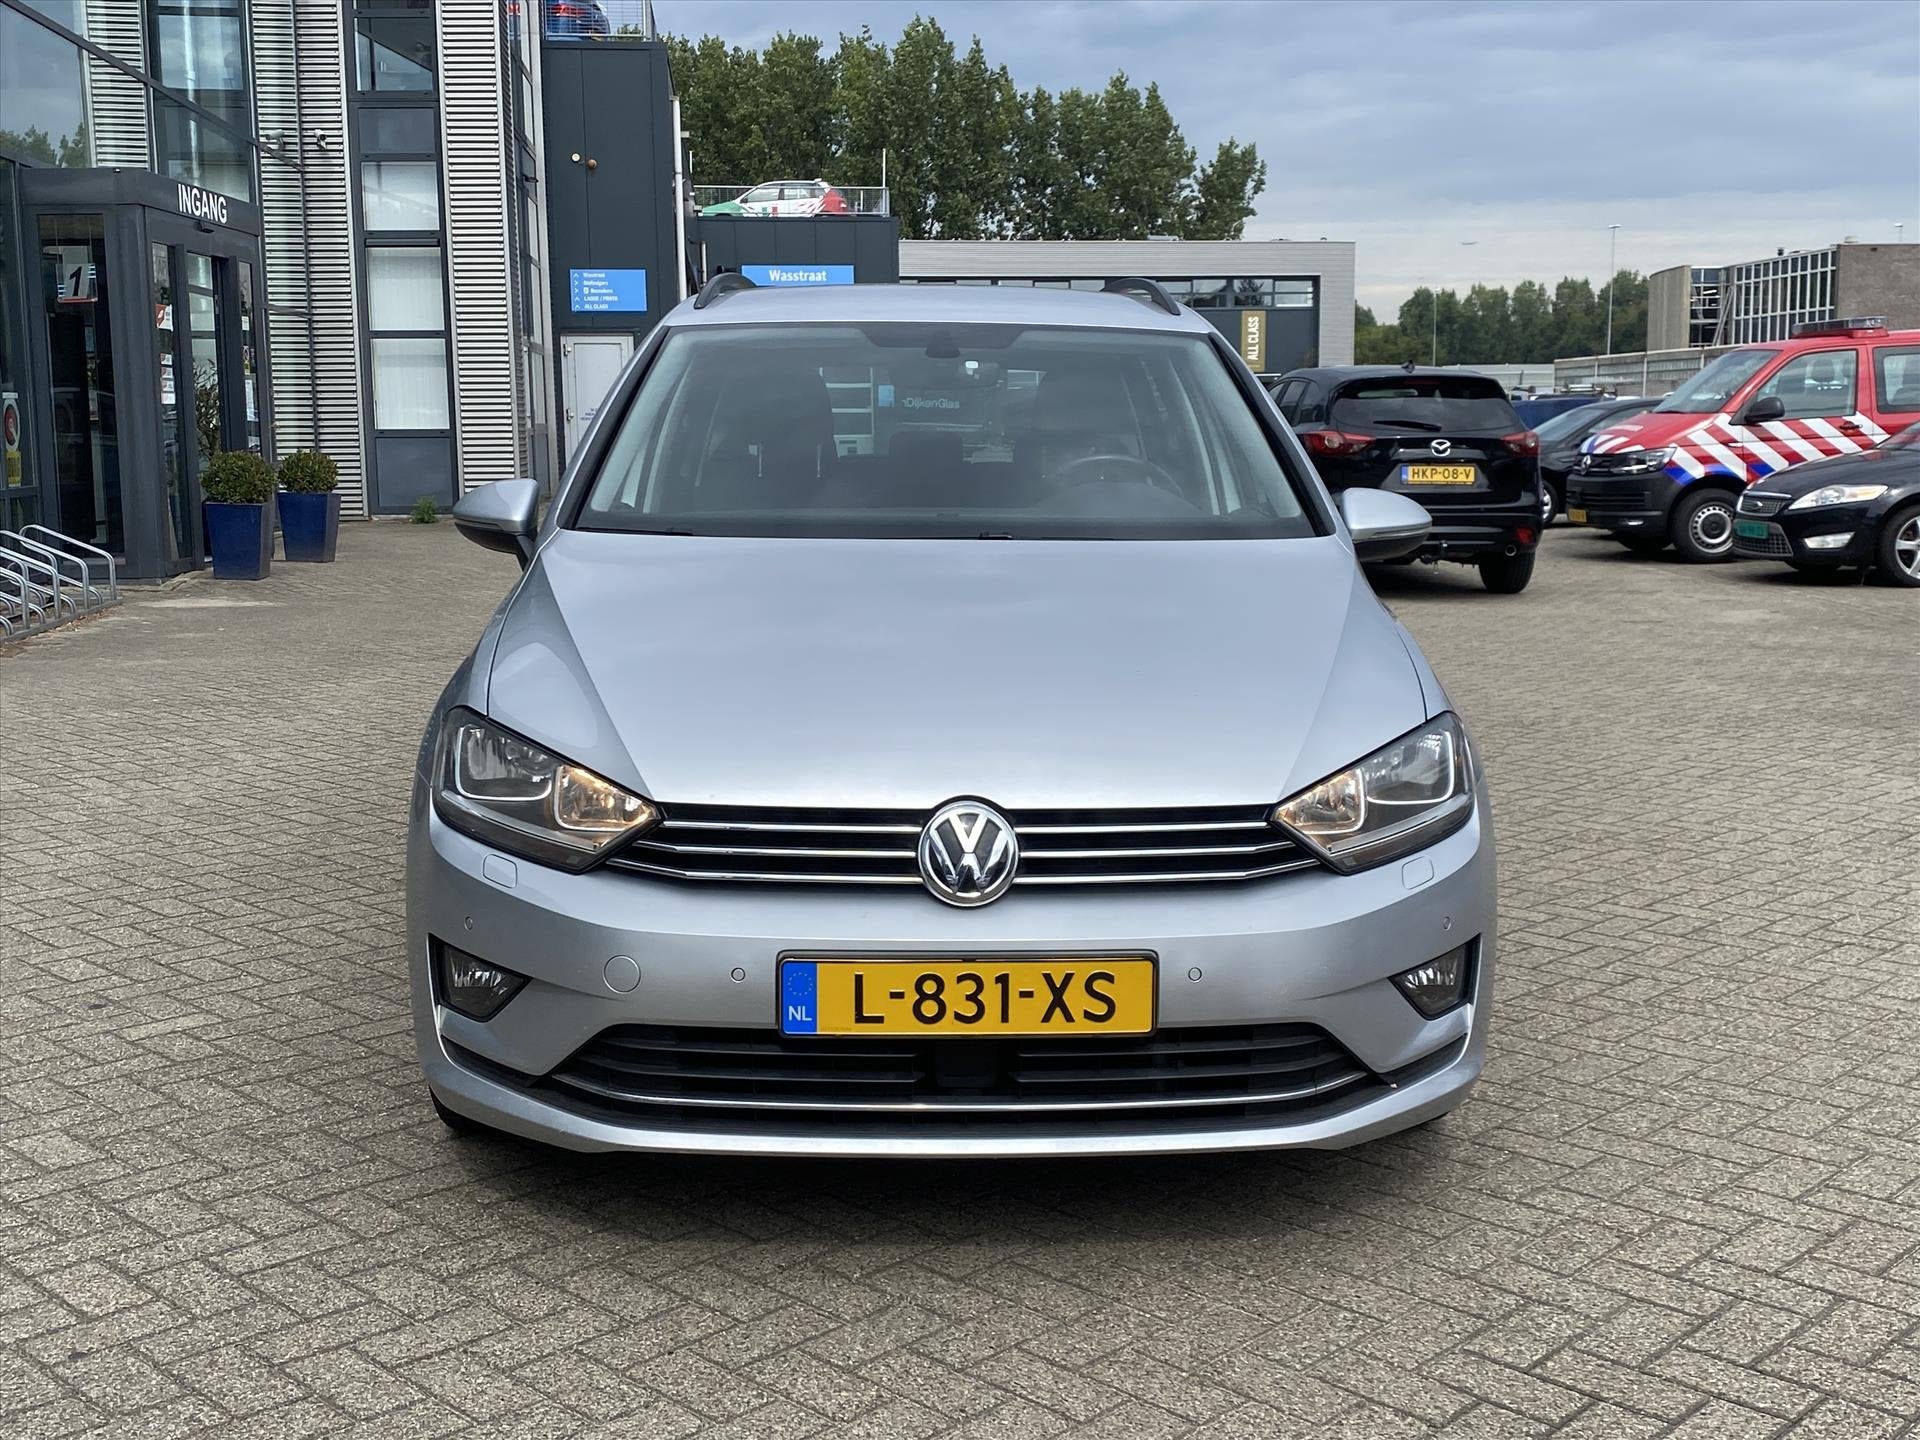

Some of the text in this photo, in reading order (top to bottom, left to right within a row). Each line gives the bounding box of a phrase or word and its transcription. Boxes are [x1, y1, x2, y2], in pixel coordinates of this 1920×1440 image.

[177, 183, 228, 224] INGANG
[69, 265, 82, 297] 1
[768, 269, 827, 282] Wasstraat
[1247, 316, 1259, 361] ALL CLASS
[1411, 468, 1471, 480] HKP-08-V
[788, 1005, 813, 1022] NL
[853, 970, 1117, 1025] L-831-XS
